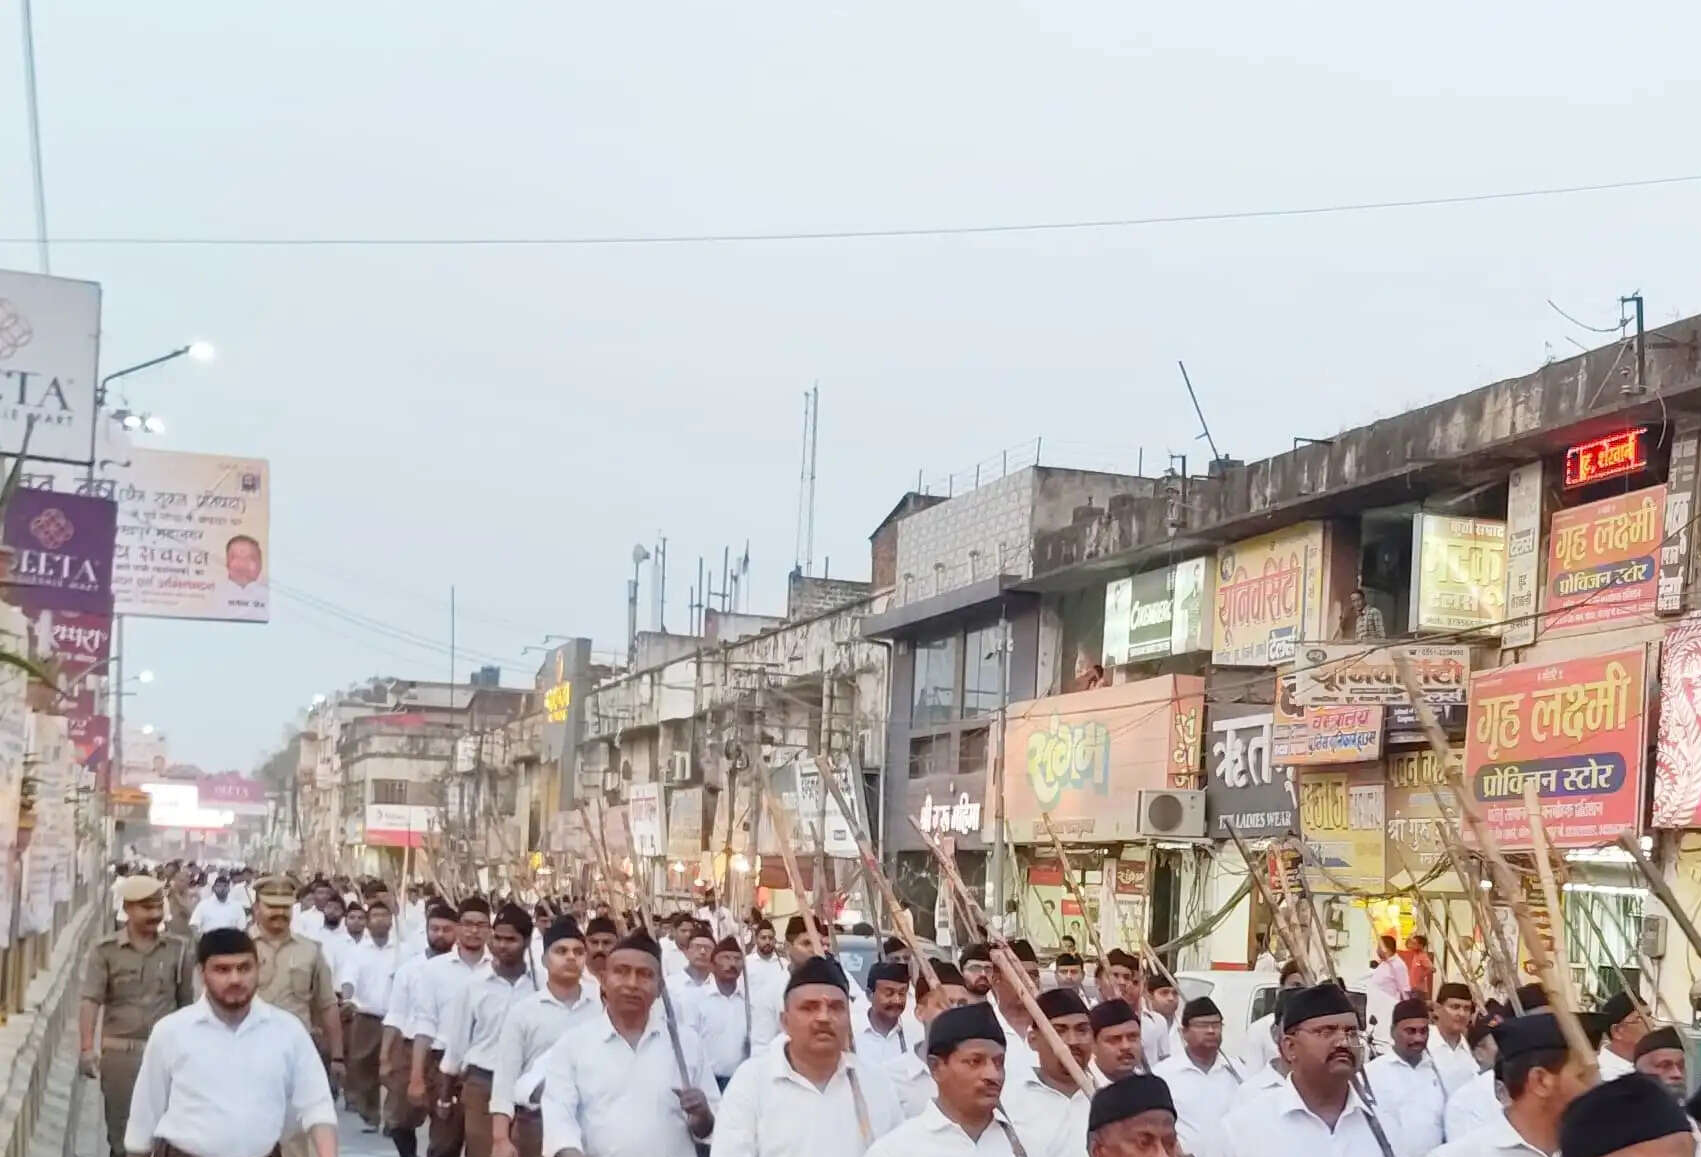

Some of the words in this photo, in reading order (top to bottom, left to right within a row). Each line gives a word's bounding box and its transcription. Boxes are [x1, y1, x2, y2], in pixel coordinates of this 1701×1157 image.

[1554, 521, 1590, 570] गृह
[1593, 496, 1658, 554] लक्ष्मी
[1476, 694, 1525, 760] गृह
[1531, 661, 1632, 743] लक्ष्मी
[1027, 712, 1112, 809] संगम
[1483, 765, 1557, 797] प्रोविजन
[1562, 758, 1614, 791] स्टोर
[1236, 811, 1265, 829] LADIES
[1267, 810, 1292, 828] WEAR
